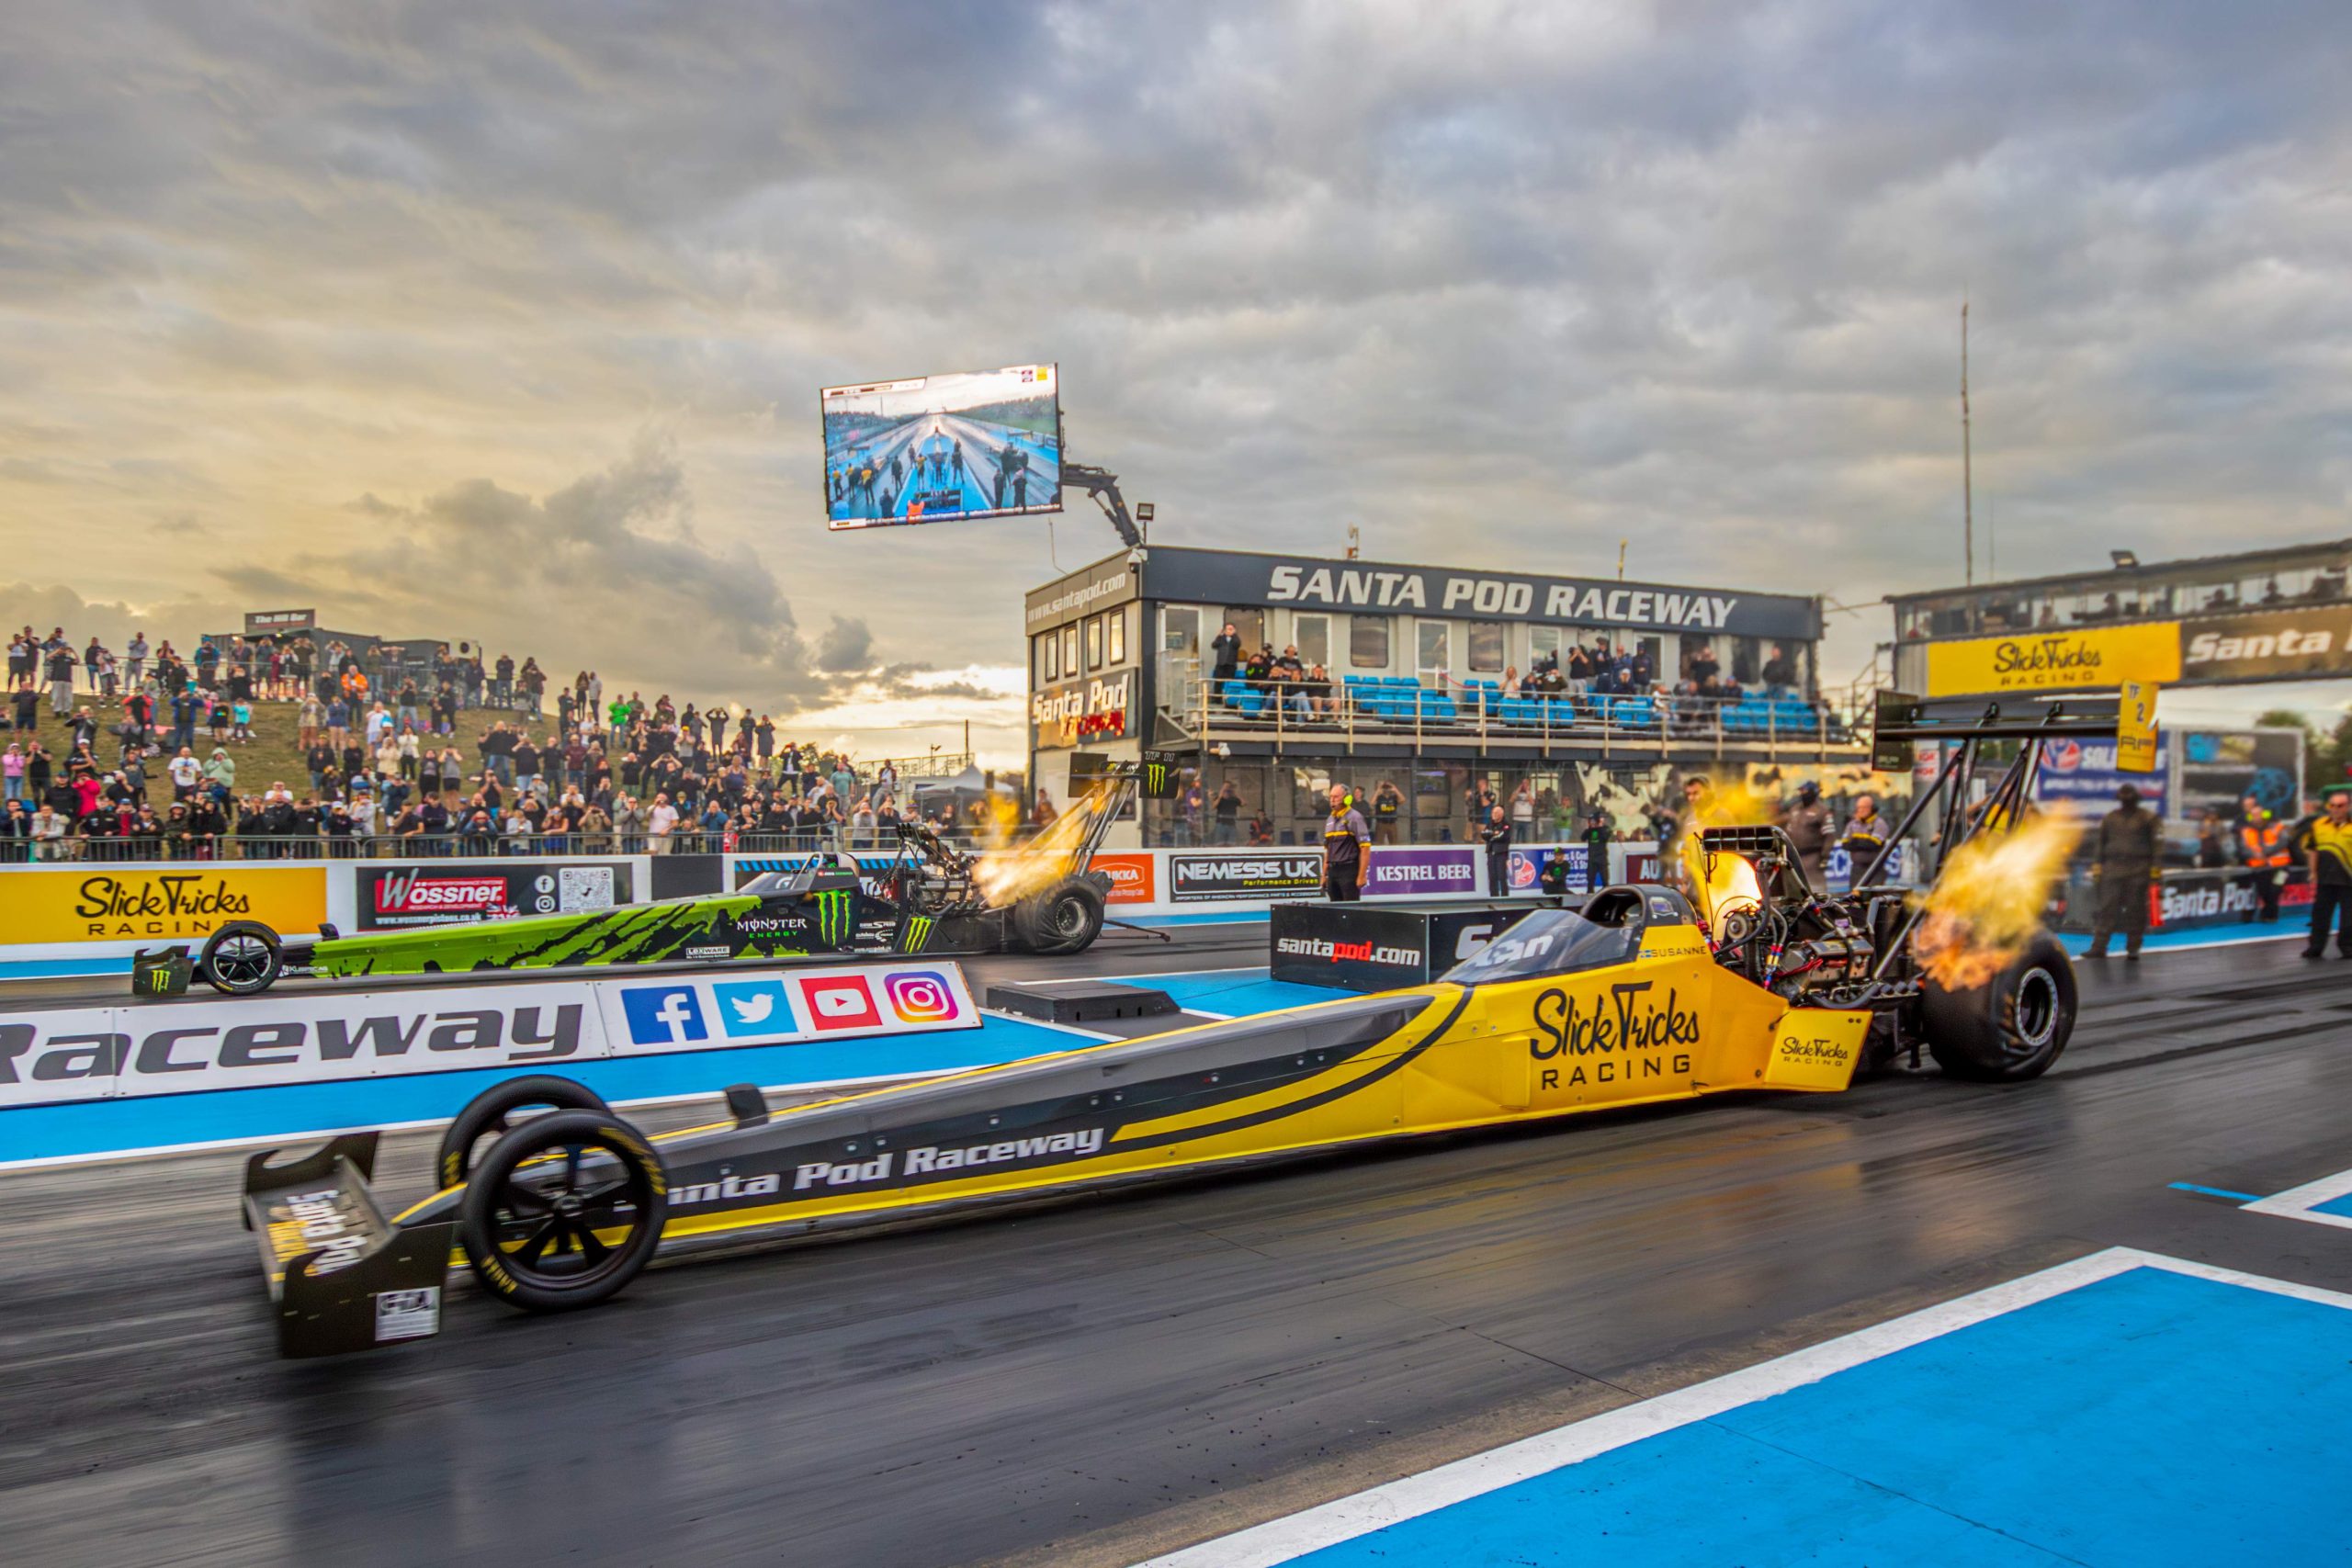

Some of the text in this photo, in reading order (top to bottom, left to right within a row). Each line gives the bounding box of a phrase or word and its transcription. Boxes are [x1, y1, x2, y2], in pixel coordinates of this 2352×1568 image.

[1027, 573, 1126, 624] www.santapod.com
[1267, 565, 1737, 628] SANTA POD RACEWAY
[2185, 629, 2334, 664] Santa
[2000, 671, 2096, 686] RACING
[1032, 690, 1084, 725] Santa
[1087, 673, 1129, 715] Pod
[2136, 702, 2145, 723] 2
[1177, 860, 1317, 881] NEMESIS UK
[1376, 864, 1472, 881] KESTREL BEER
[2162, 886, 2221, 919] Santa
[88, 919, 239, 936] RACIN
[737, 918, 808, 932] MONSTER
[749, 931, 797, 939] ENERGY
[1277, 937, 1420, 966] santapod.com
[1651, 944, 1707, 958] SUSANNE
[1783, 1055, 1843, 1067] RACING
[1541, 1054, 1691, 1090] RACING
[667, 1127, 1104, 1206] nta Pod Raceway
